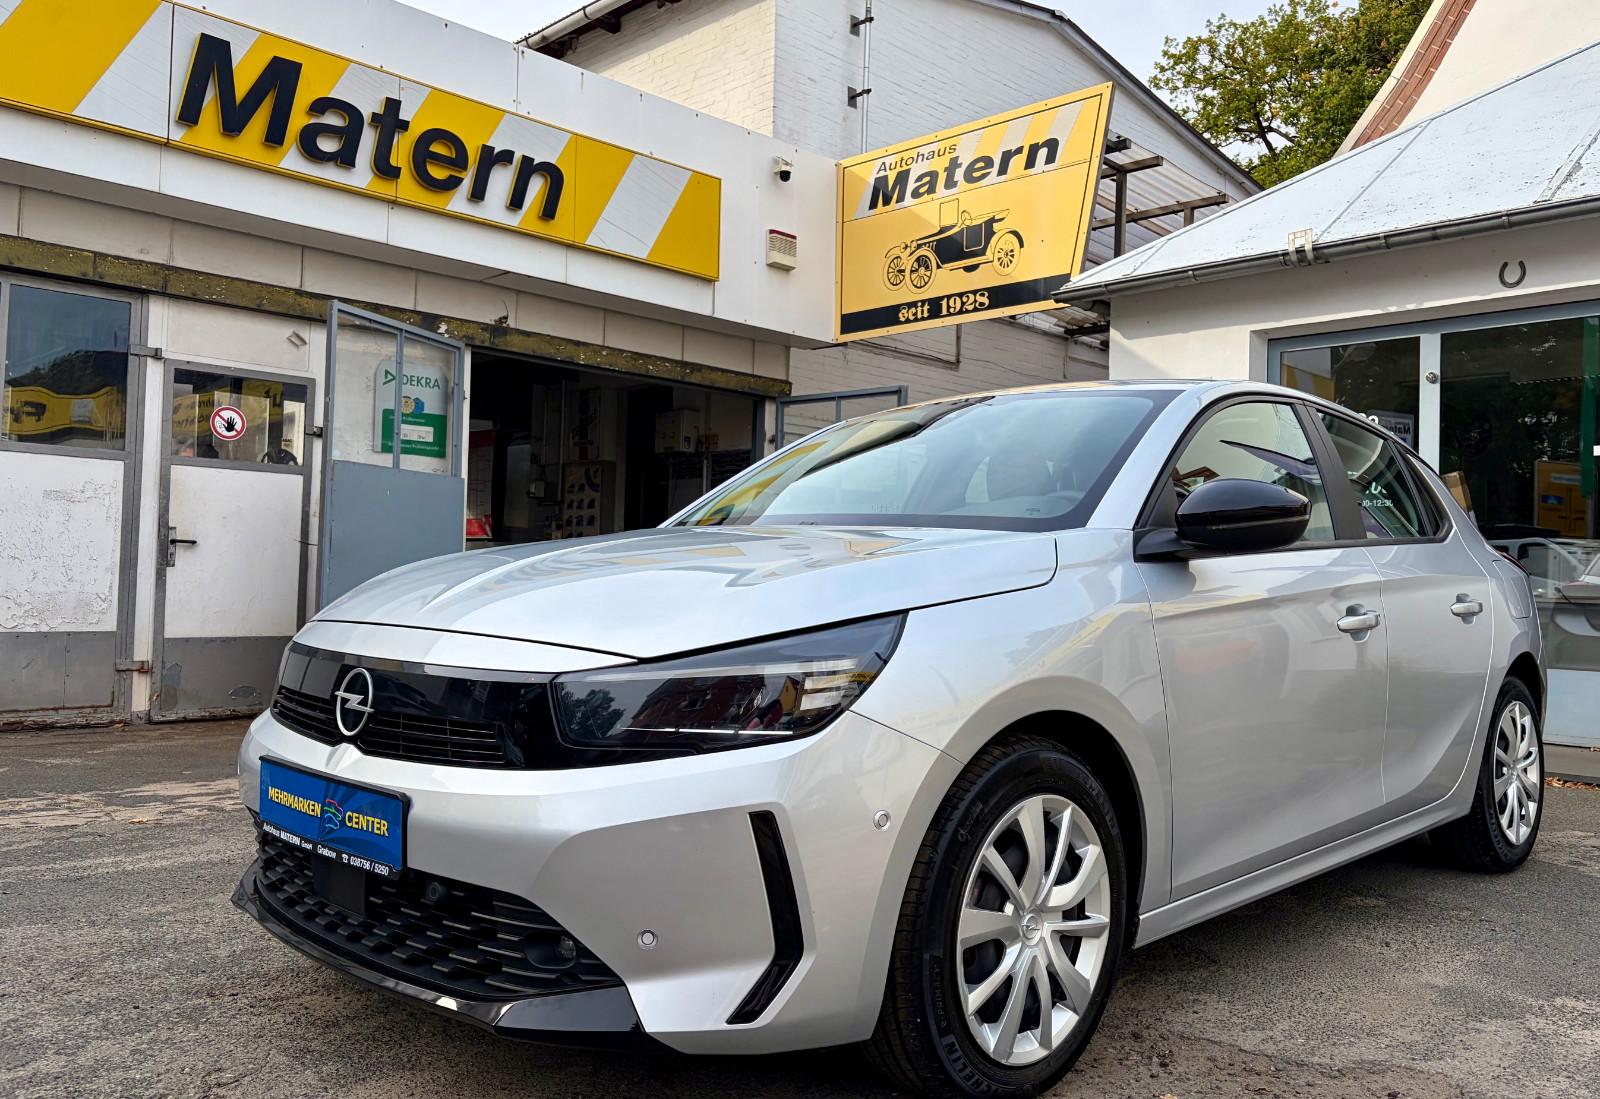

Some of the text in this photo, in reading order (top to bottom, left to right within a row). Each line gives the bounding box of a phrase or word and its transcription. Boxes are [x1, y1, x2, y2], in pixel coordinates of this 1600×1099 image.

[177, 33, 565, 222] Matern
[868, 136, 1061, 211] Matern
[876, 143, 958, 174] Autohaus
[898, 290, 990, 322] seit 1928
[401, 374, 441, 390] DEKRA
[268, 785, 322, 818] MEHRMARKEN
[345, 812, 388, 836] CENTER
[280, 830, 301, 846] MATERN
[317, 844, 337, 859] Grabow
[350, 856, 371, 870] 038756
[374, 863, 389, 876] 5250
